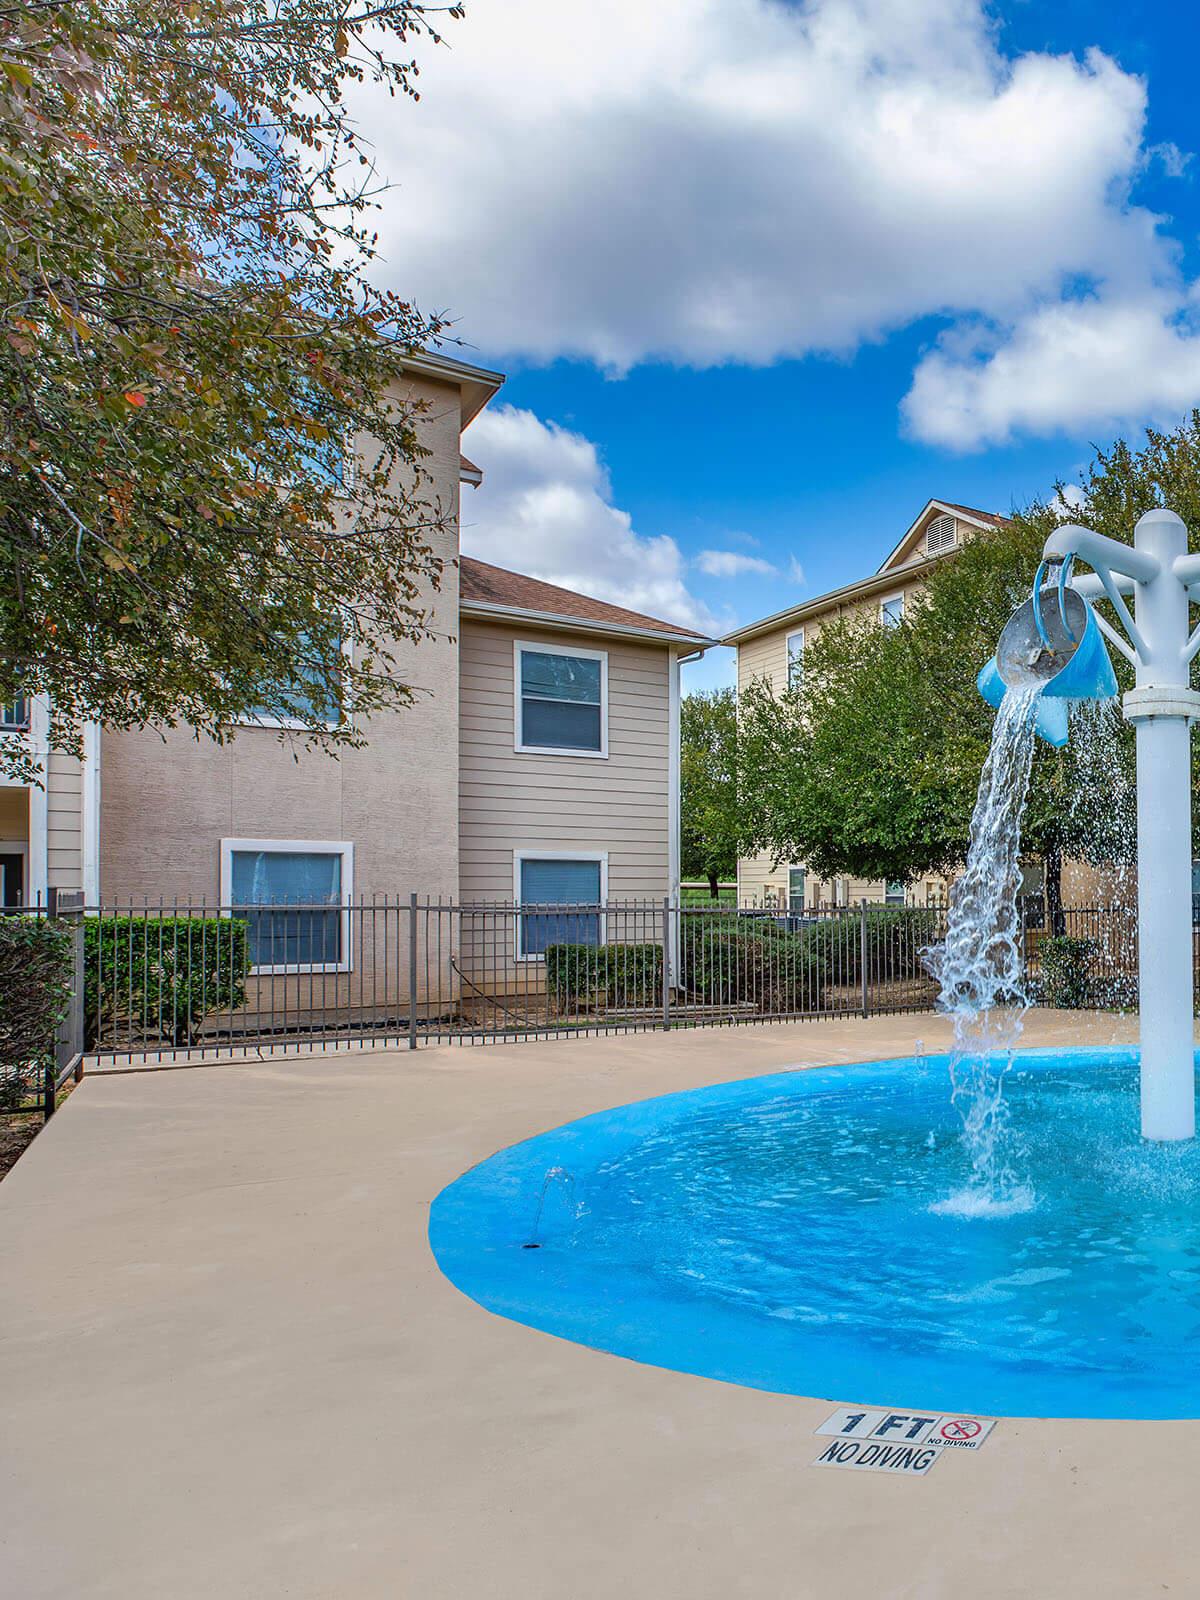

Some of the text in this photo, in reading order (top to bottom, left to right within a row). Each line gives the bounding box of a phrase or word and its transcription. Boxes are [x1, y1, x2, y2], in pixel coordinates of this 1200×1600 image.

[841, 1413, 936, 1439] 1 FT
[819, 1441, 936, 1470] NO DIVING
[943, 1440, 976, 1448] DIVING
